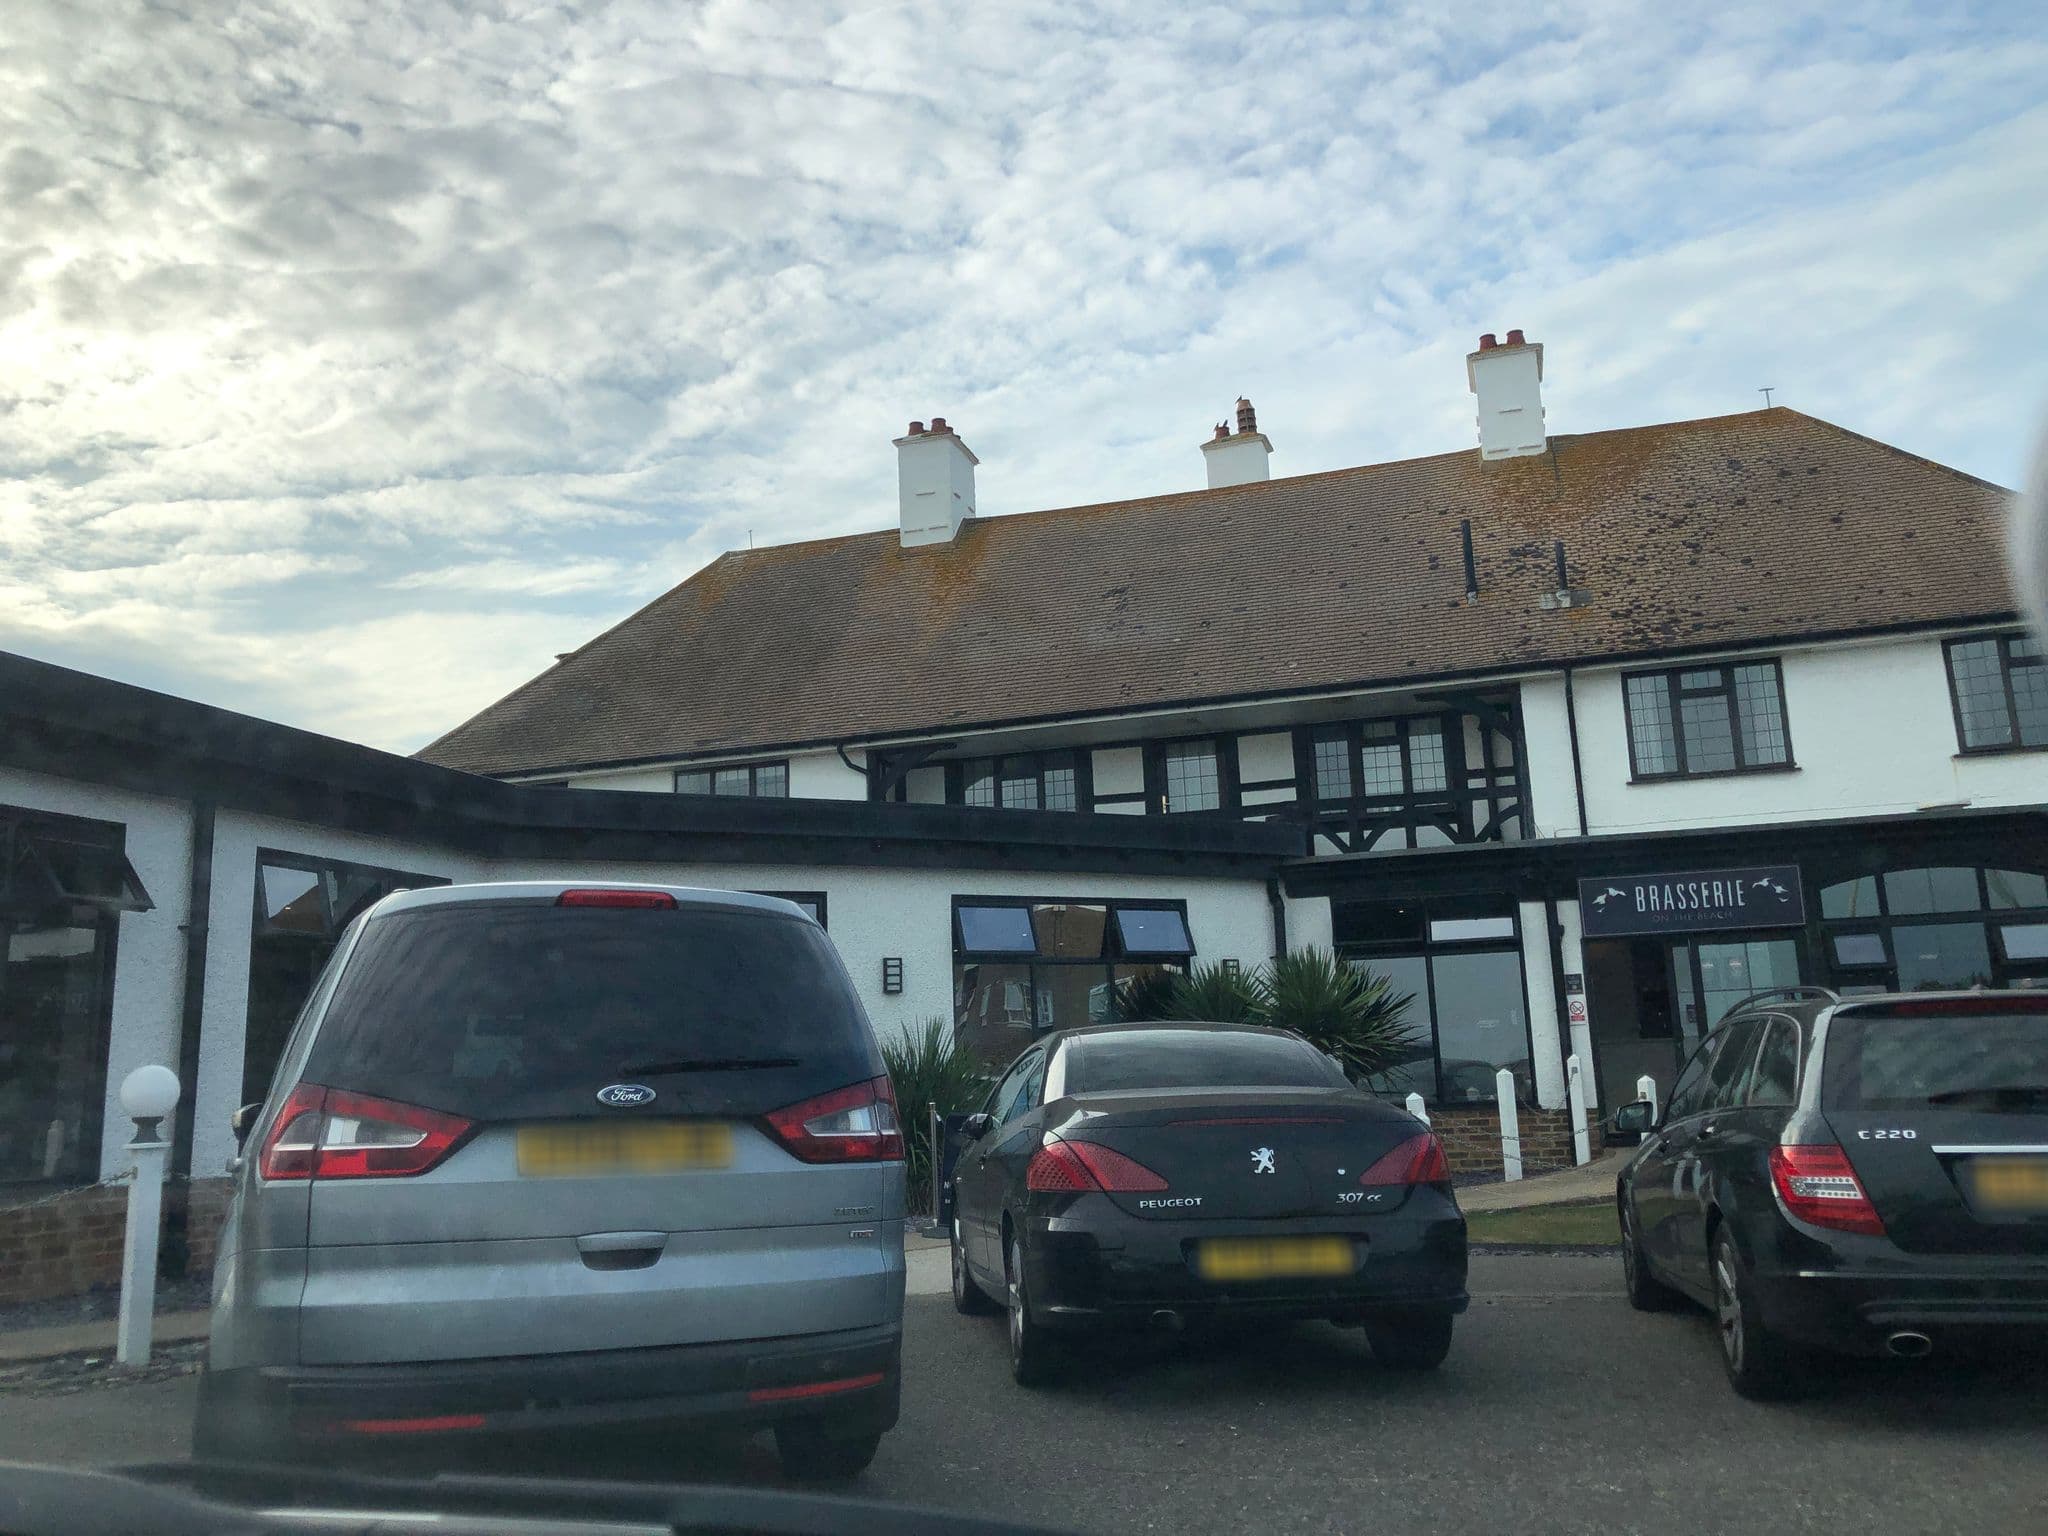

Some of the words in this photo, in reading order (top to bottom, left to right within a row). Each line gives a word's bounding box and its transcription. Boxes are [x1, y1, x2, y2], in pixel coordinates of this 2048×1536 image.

[1635, 880, 1746, 912] BRASSERIE
[1697, 911, 1733, 921] BEACH
[611, 1087, 644, 1102] Ford
[1857, 1130, 1870, 1140] C
[1875, 1130, 1917, 1139] 220
[1139, 1198, 1203, 1209] PEUGEOT
[1336, 1192, 1363, 1204] 307
